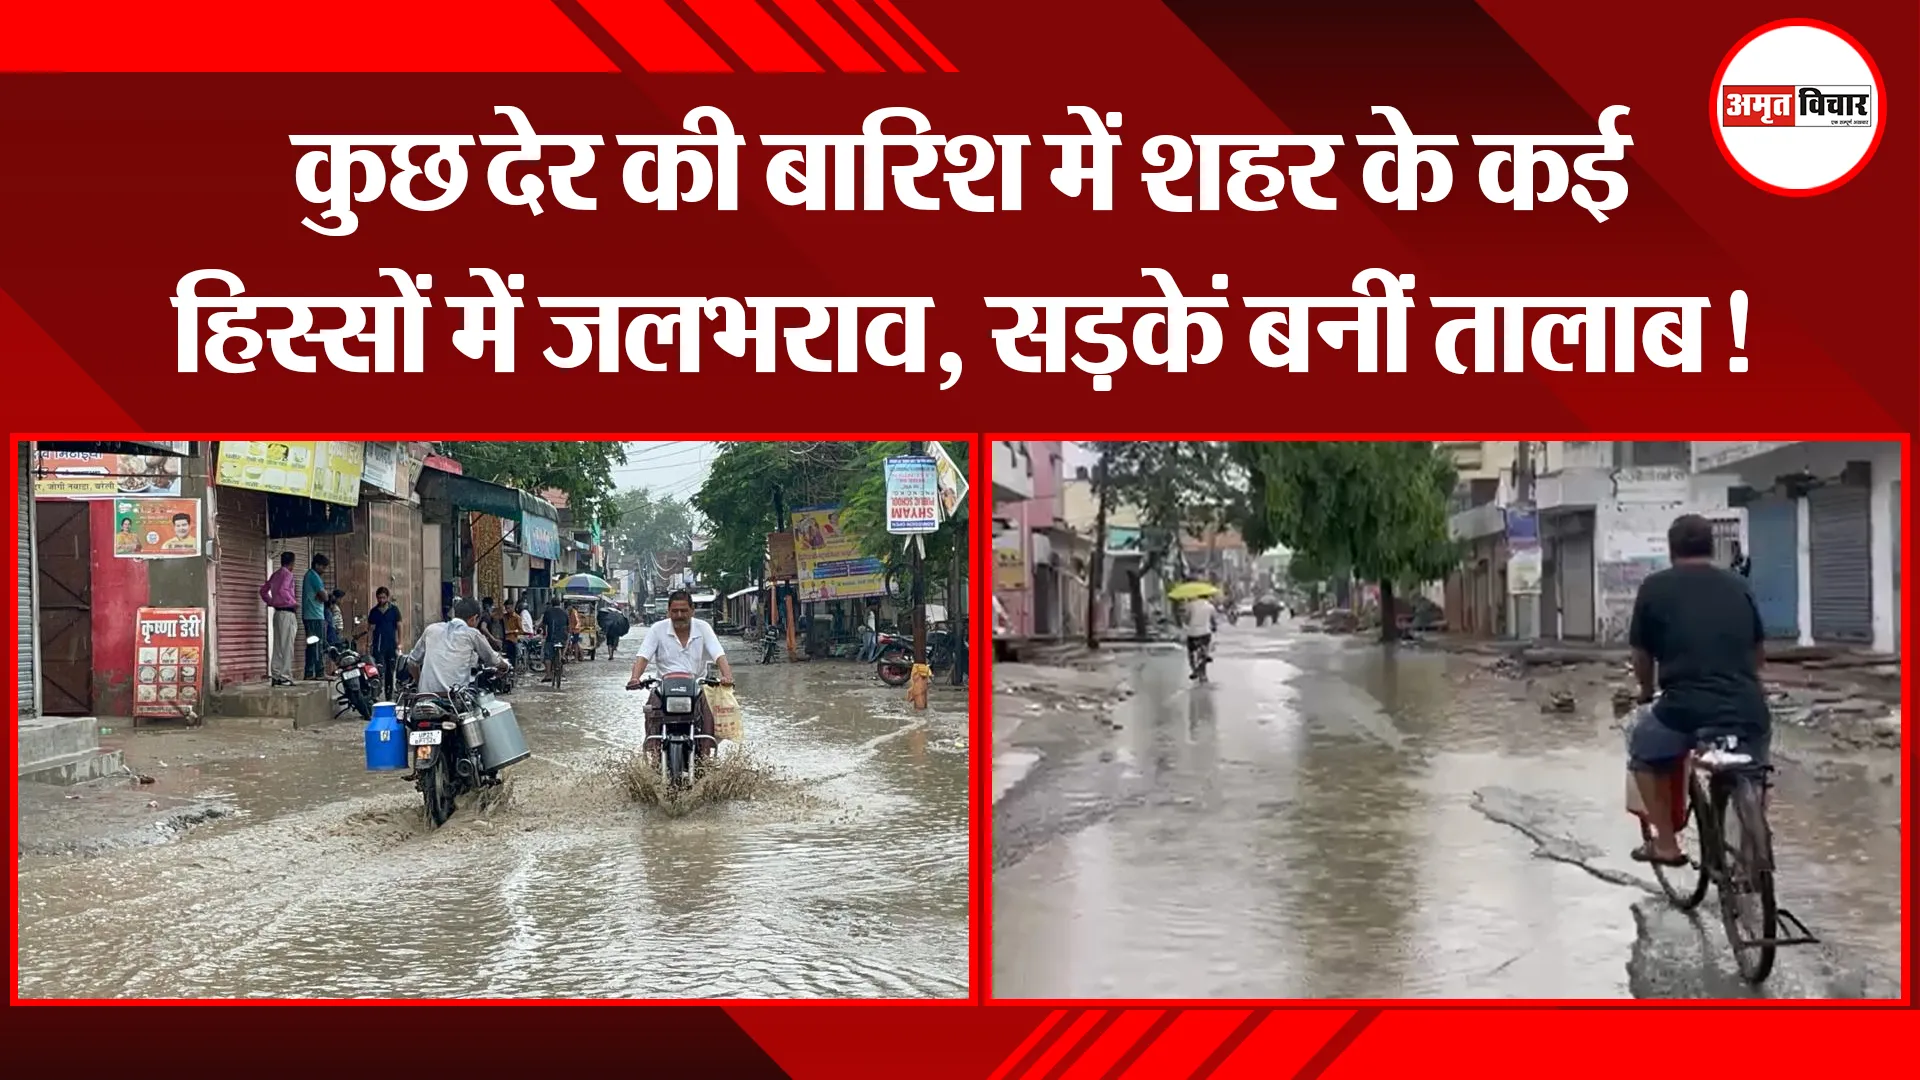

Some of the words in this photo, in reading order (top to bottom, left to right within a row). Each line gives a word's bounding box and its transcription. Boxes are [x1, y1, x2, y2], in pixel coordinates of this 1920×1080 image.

[891, 496, 913, 507] SCHOOL
[913, 496, 935, 507] PUBLIC
[892, 507, 934, 519] SHYAM
[141, 619, 178, 644] कृष्णा
[179, 614, 201, 639] डेरी
